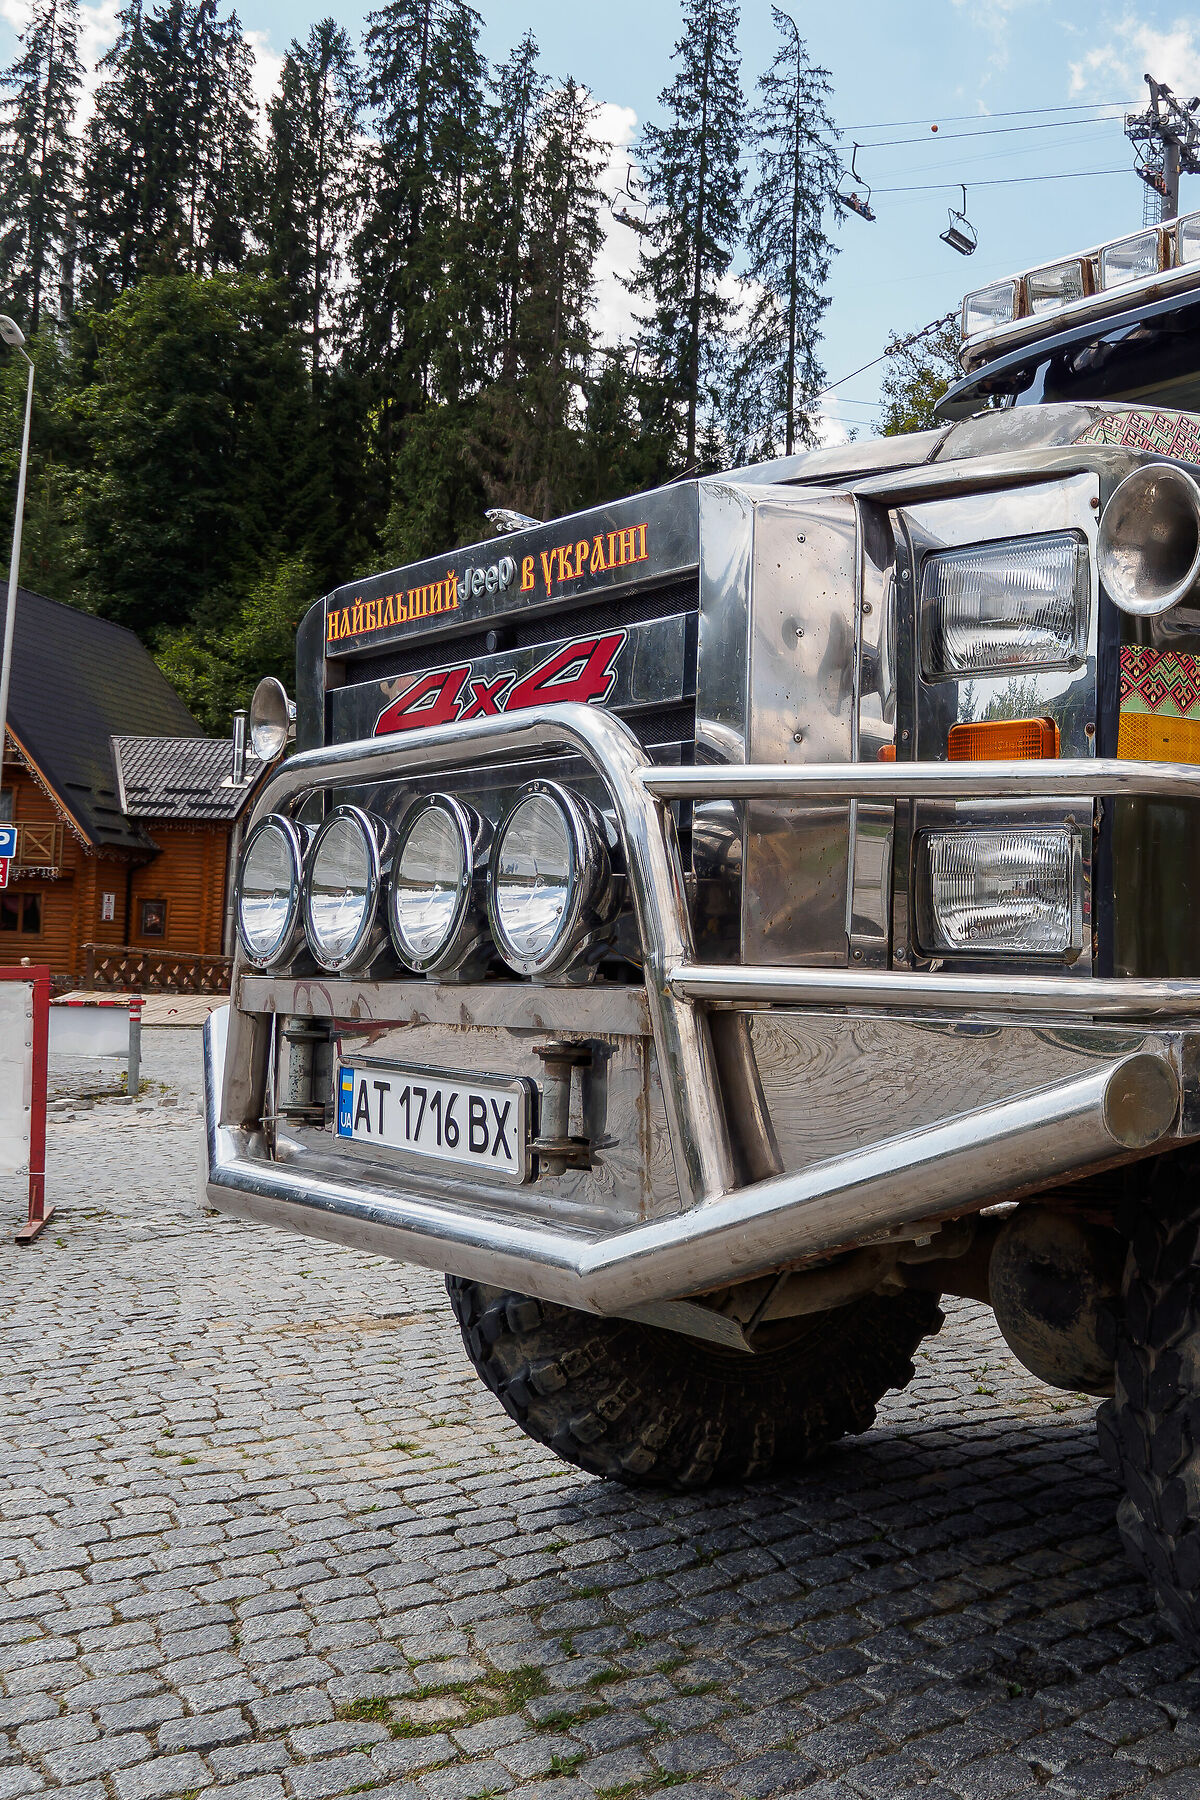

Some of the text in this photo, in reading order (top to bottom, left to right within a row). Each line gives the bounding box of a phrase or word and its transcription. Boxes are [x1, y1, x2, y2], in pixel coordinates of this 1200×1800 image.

[327, 569, 459, 642] НАЙБІЛЬШИЙ
[457, 556, 517, 600] Jeep
[372, 628, 630, 736] 4x4
[340, 1112, 352, 1129] UA
[354, 1079, 512, 1159] AT 1716 BX
